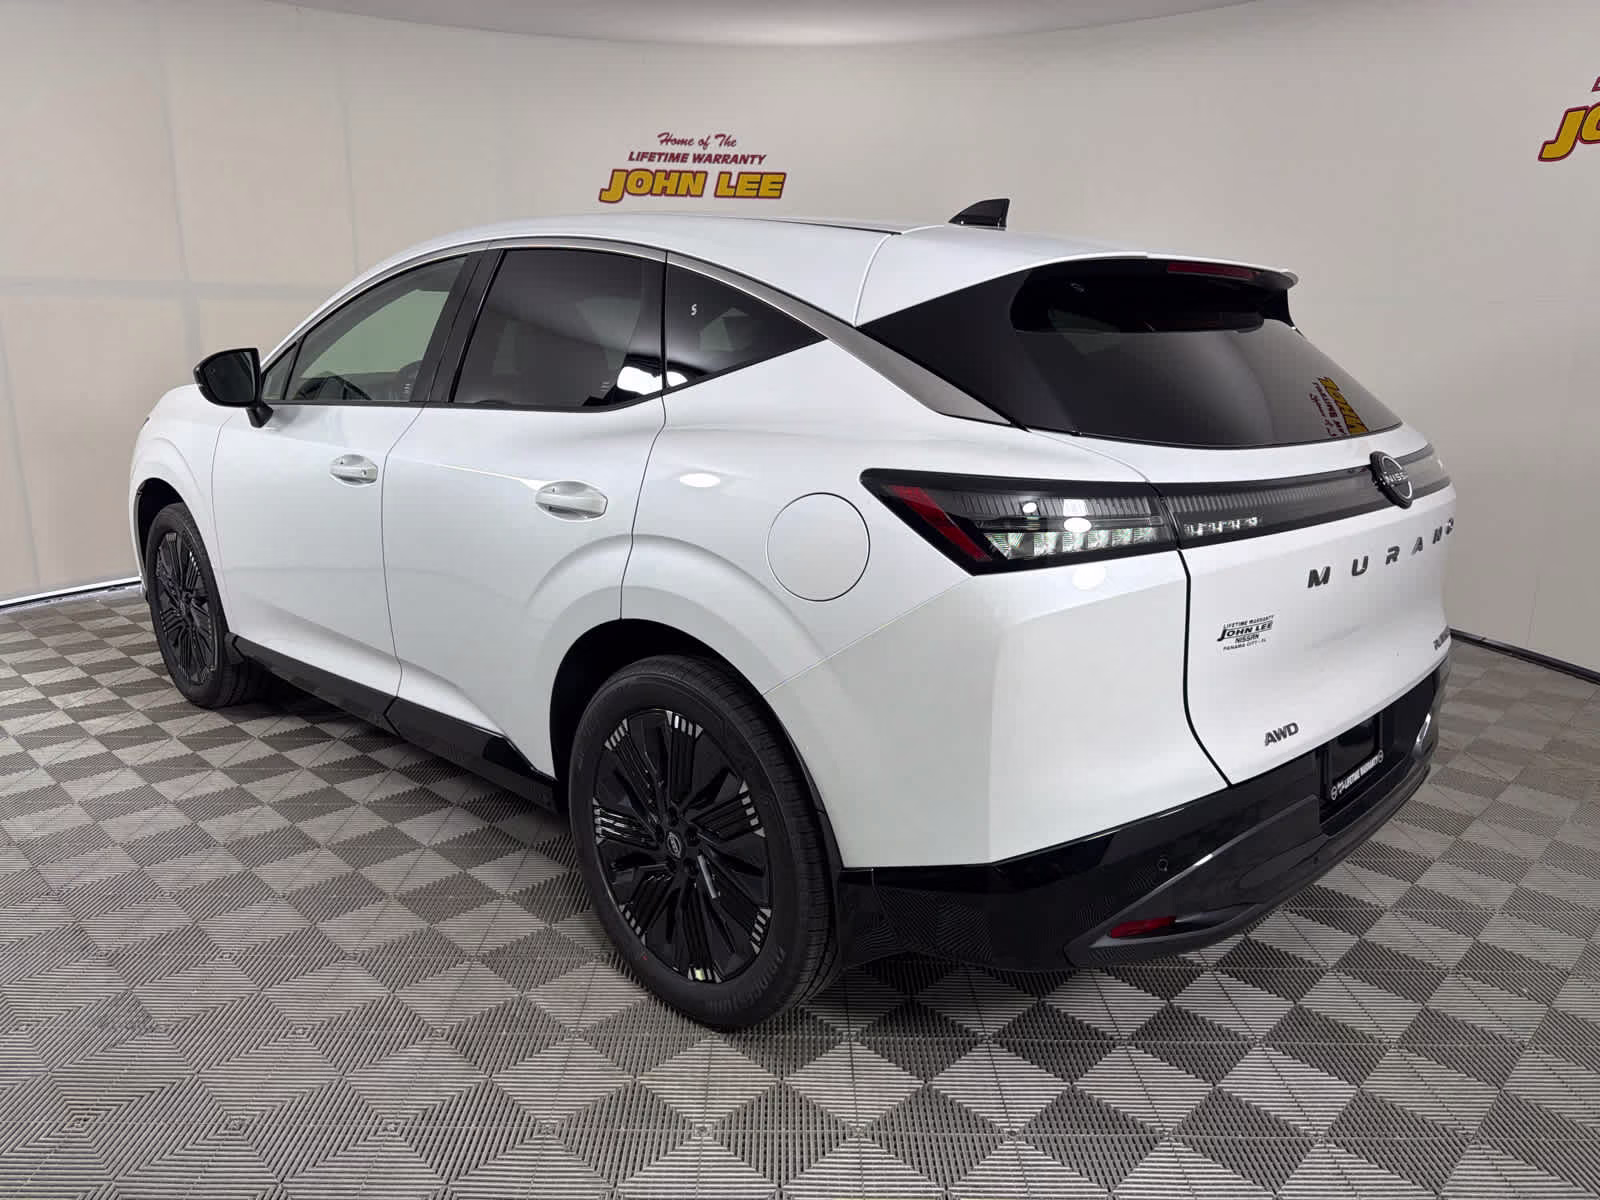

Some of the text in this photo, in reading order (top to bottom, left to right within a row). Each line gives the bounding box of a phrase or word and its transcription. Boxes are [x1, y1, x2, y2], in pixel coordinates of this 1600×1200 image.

[657, 132, 737, 150] Home of The
[628, 151, 767, 165] LIFETIME WARRANTY
[599, 168, 787, 204] JOHN LEE
[1216, 626, 1253, 642] JOHN
[1264, 722, 1299, 746] AWD
